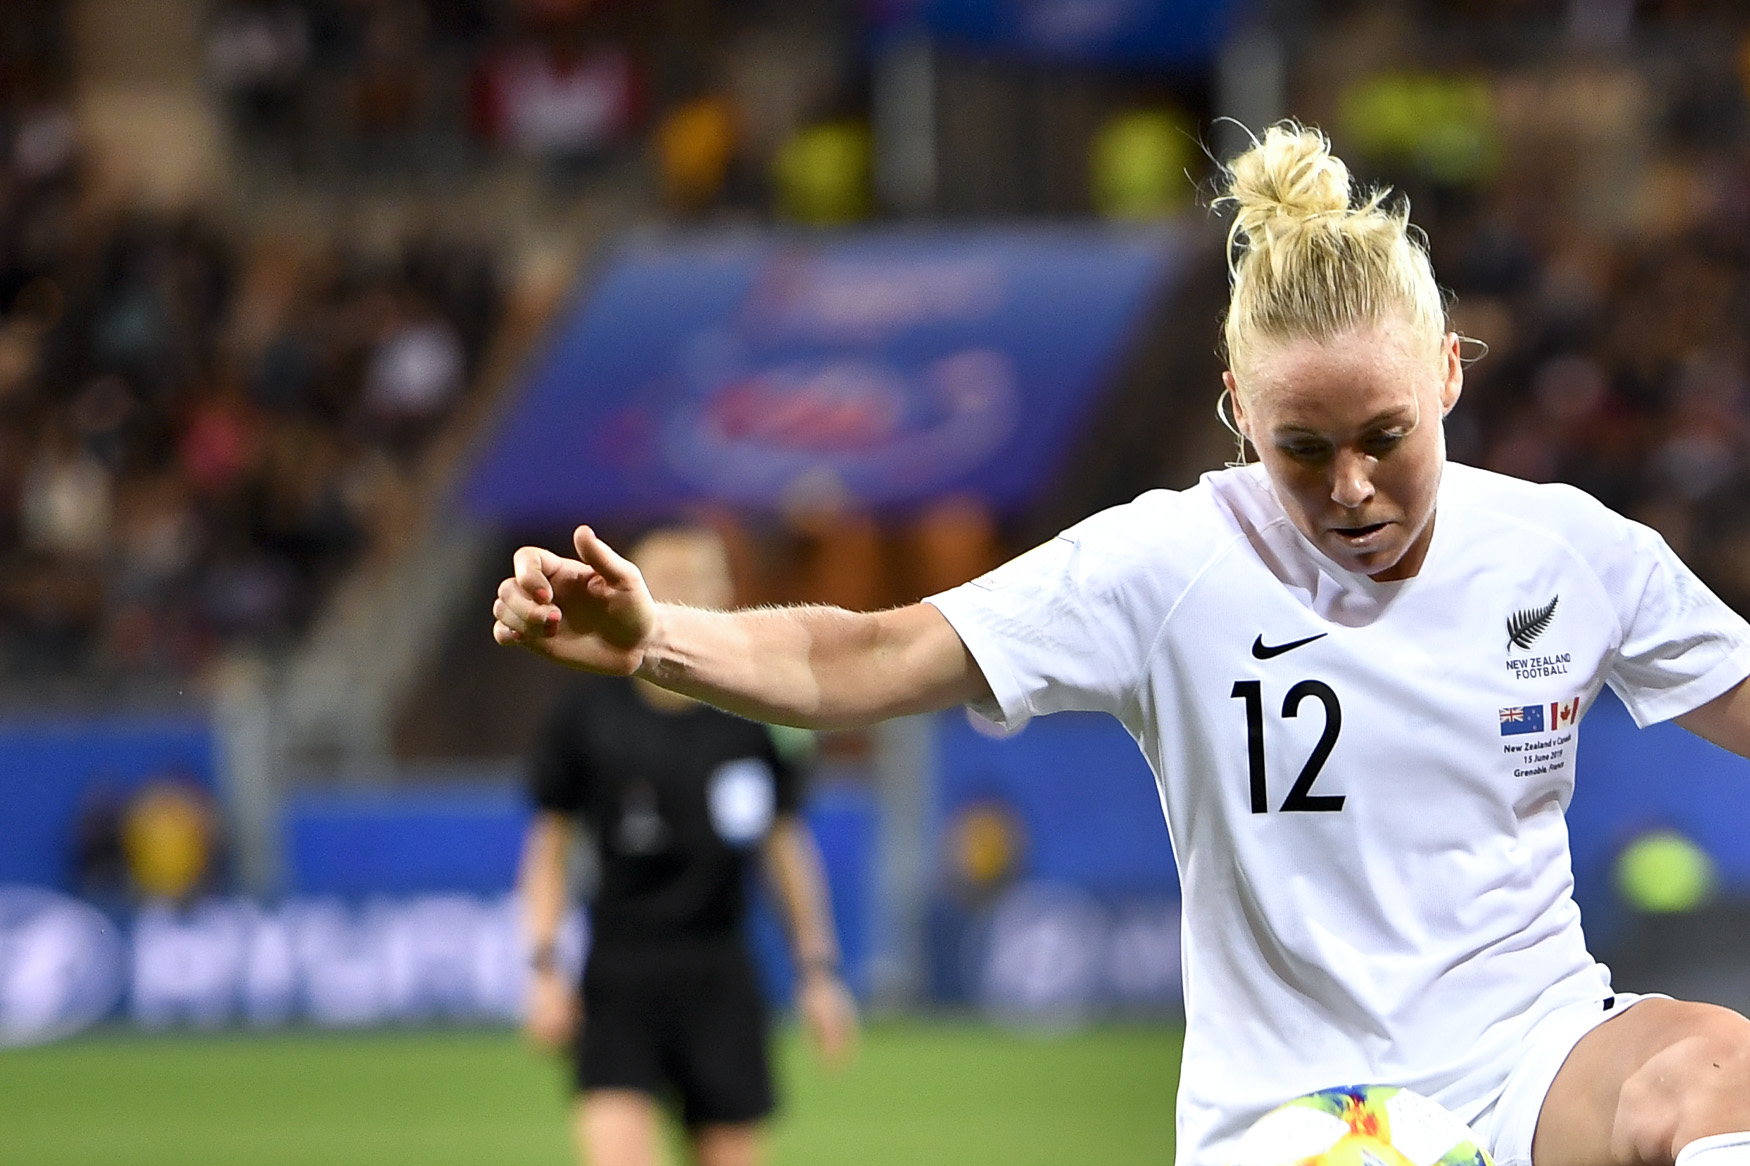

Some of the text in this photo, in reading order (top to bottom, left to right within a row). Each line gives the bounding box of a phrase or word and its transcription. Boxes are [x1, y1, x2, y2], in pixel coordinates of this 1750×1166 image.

[1506, 653, 1571, 670] NEW ZEALAND
[1516, 664, 1568, 680] FOOTBALL
[1230, 679, 1347, 814] 12
[1503, 744, 1523, 754] New
[1524, 738, 1552, 751] Zealand
[1524, 755, 1533, 764] 15
[1534, 754, 1550, 763] June
